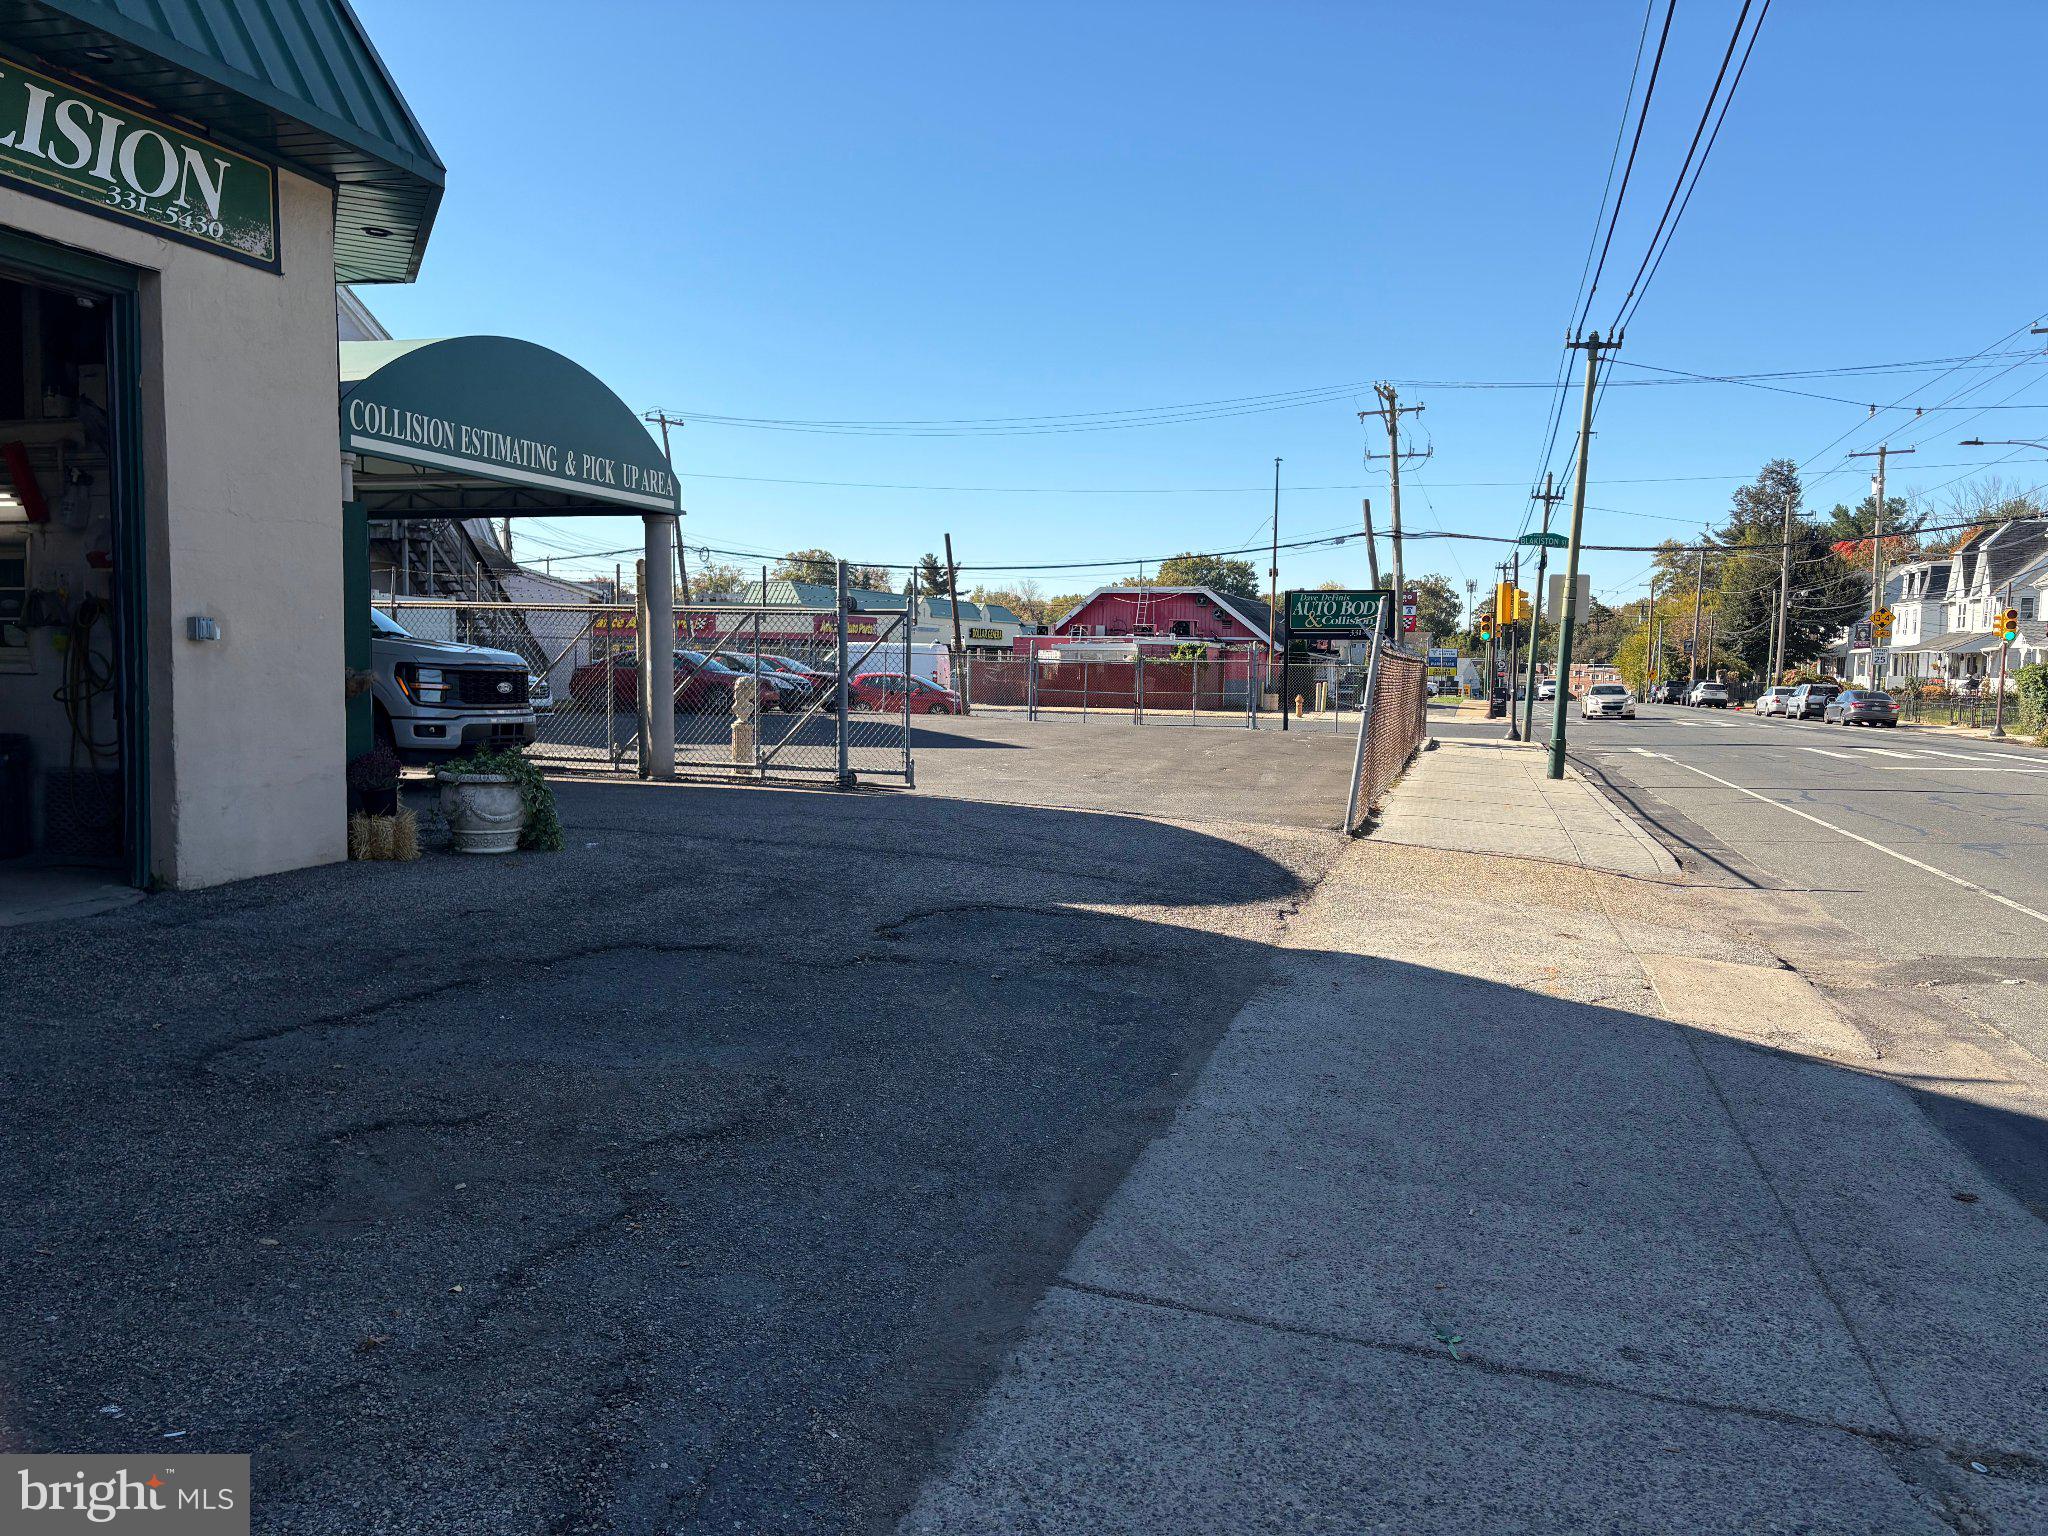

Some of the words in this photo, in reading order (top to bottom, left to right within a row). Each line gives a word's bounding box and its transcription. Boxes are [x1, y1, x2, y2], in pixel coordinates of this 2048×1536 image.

[105, 186, 225, 239] 331-5430
[349, 398, 455, 452] COLLISION
[460, 424, 558, 473] ESTIMATING
[564, 449, 577, 477] &
[582, 453, 616, 486] PICK
[622, 464, 640, 490] UP
[641, 468, 675, 497] AREA
[1520, 537, 1559, 546] BLAKISTON
[1299, 594, 1319, 602] Dave
[1292, 600, 1337, 616] AUTO
[1304, 610, 1323, 628] &
[1874, 656, 1886, 664] 25
